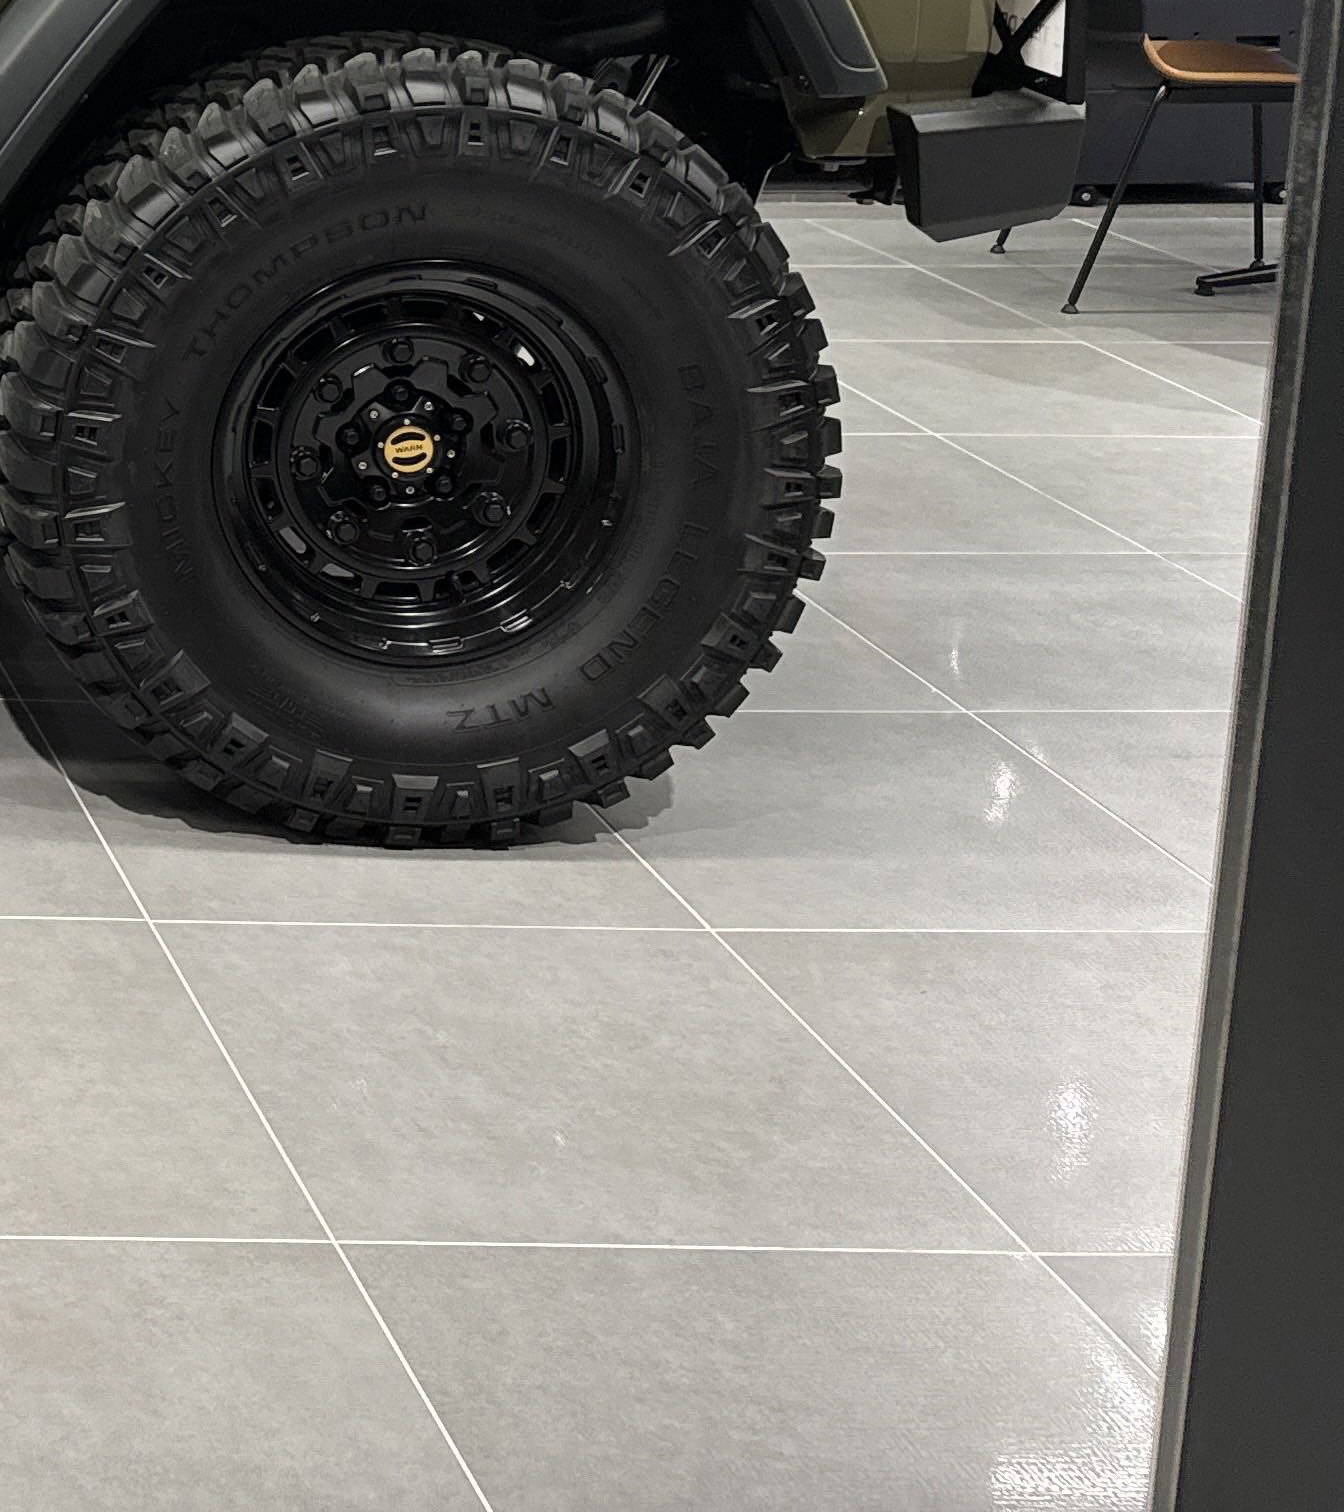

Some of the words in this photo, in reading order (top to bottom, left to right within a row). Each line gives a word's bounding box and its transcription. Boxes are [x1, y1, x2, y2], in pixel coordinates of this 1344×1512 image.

[152, 399, 197, 584] MICKEY
[180, 199, 427, 361] THOMPSON
[395, 444, 423, 454] WARN
[445, 687, 557, 731] MTZ
